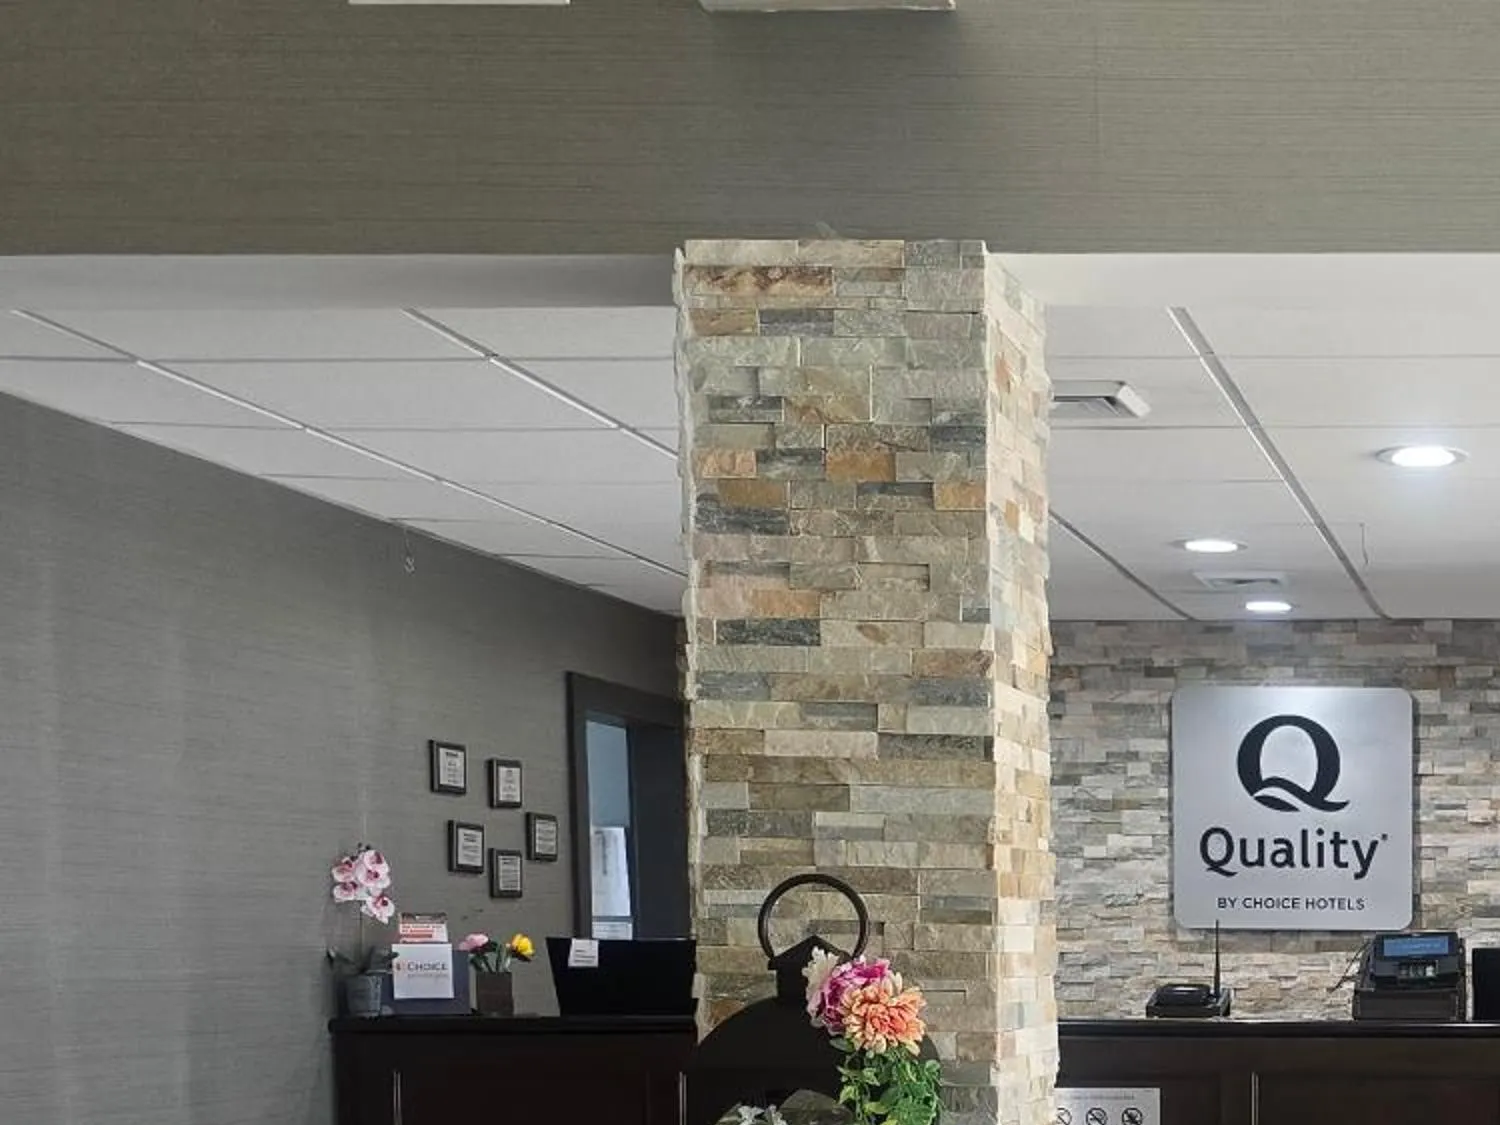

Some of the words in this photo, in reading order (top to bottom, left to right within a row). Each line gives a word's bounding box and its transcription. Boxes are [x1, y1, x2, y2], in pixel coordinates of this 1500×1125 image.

[1237, 714, 1350, 813] Q
[1200, 827, 1380, 880] Quality
[1217, 897, 1238, 909] BY
[1242, 897, 1300, 909] CHOICE
[1304, 897, 1366, 911] HOTELS
